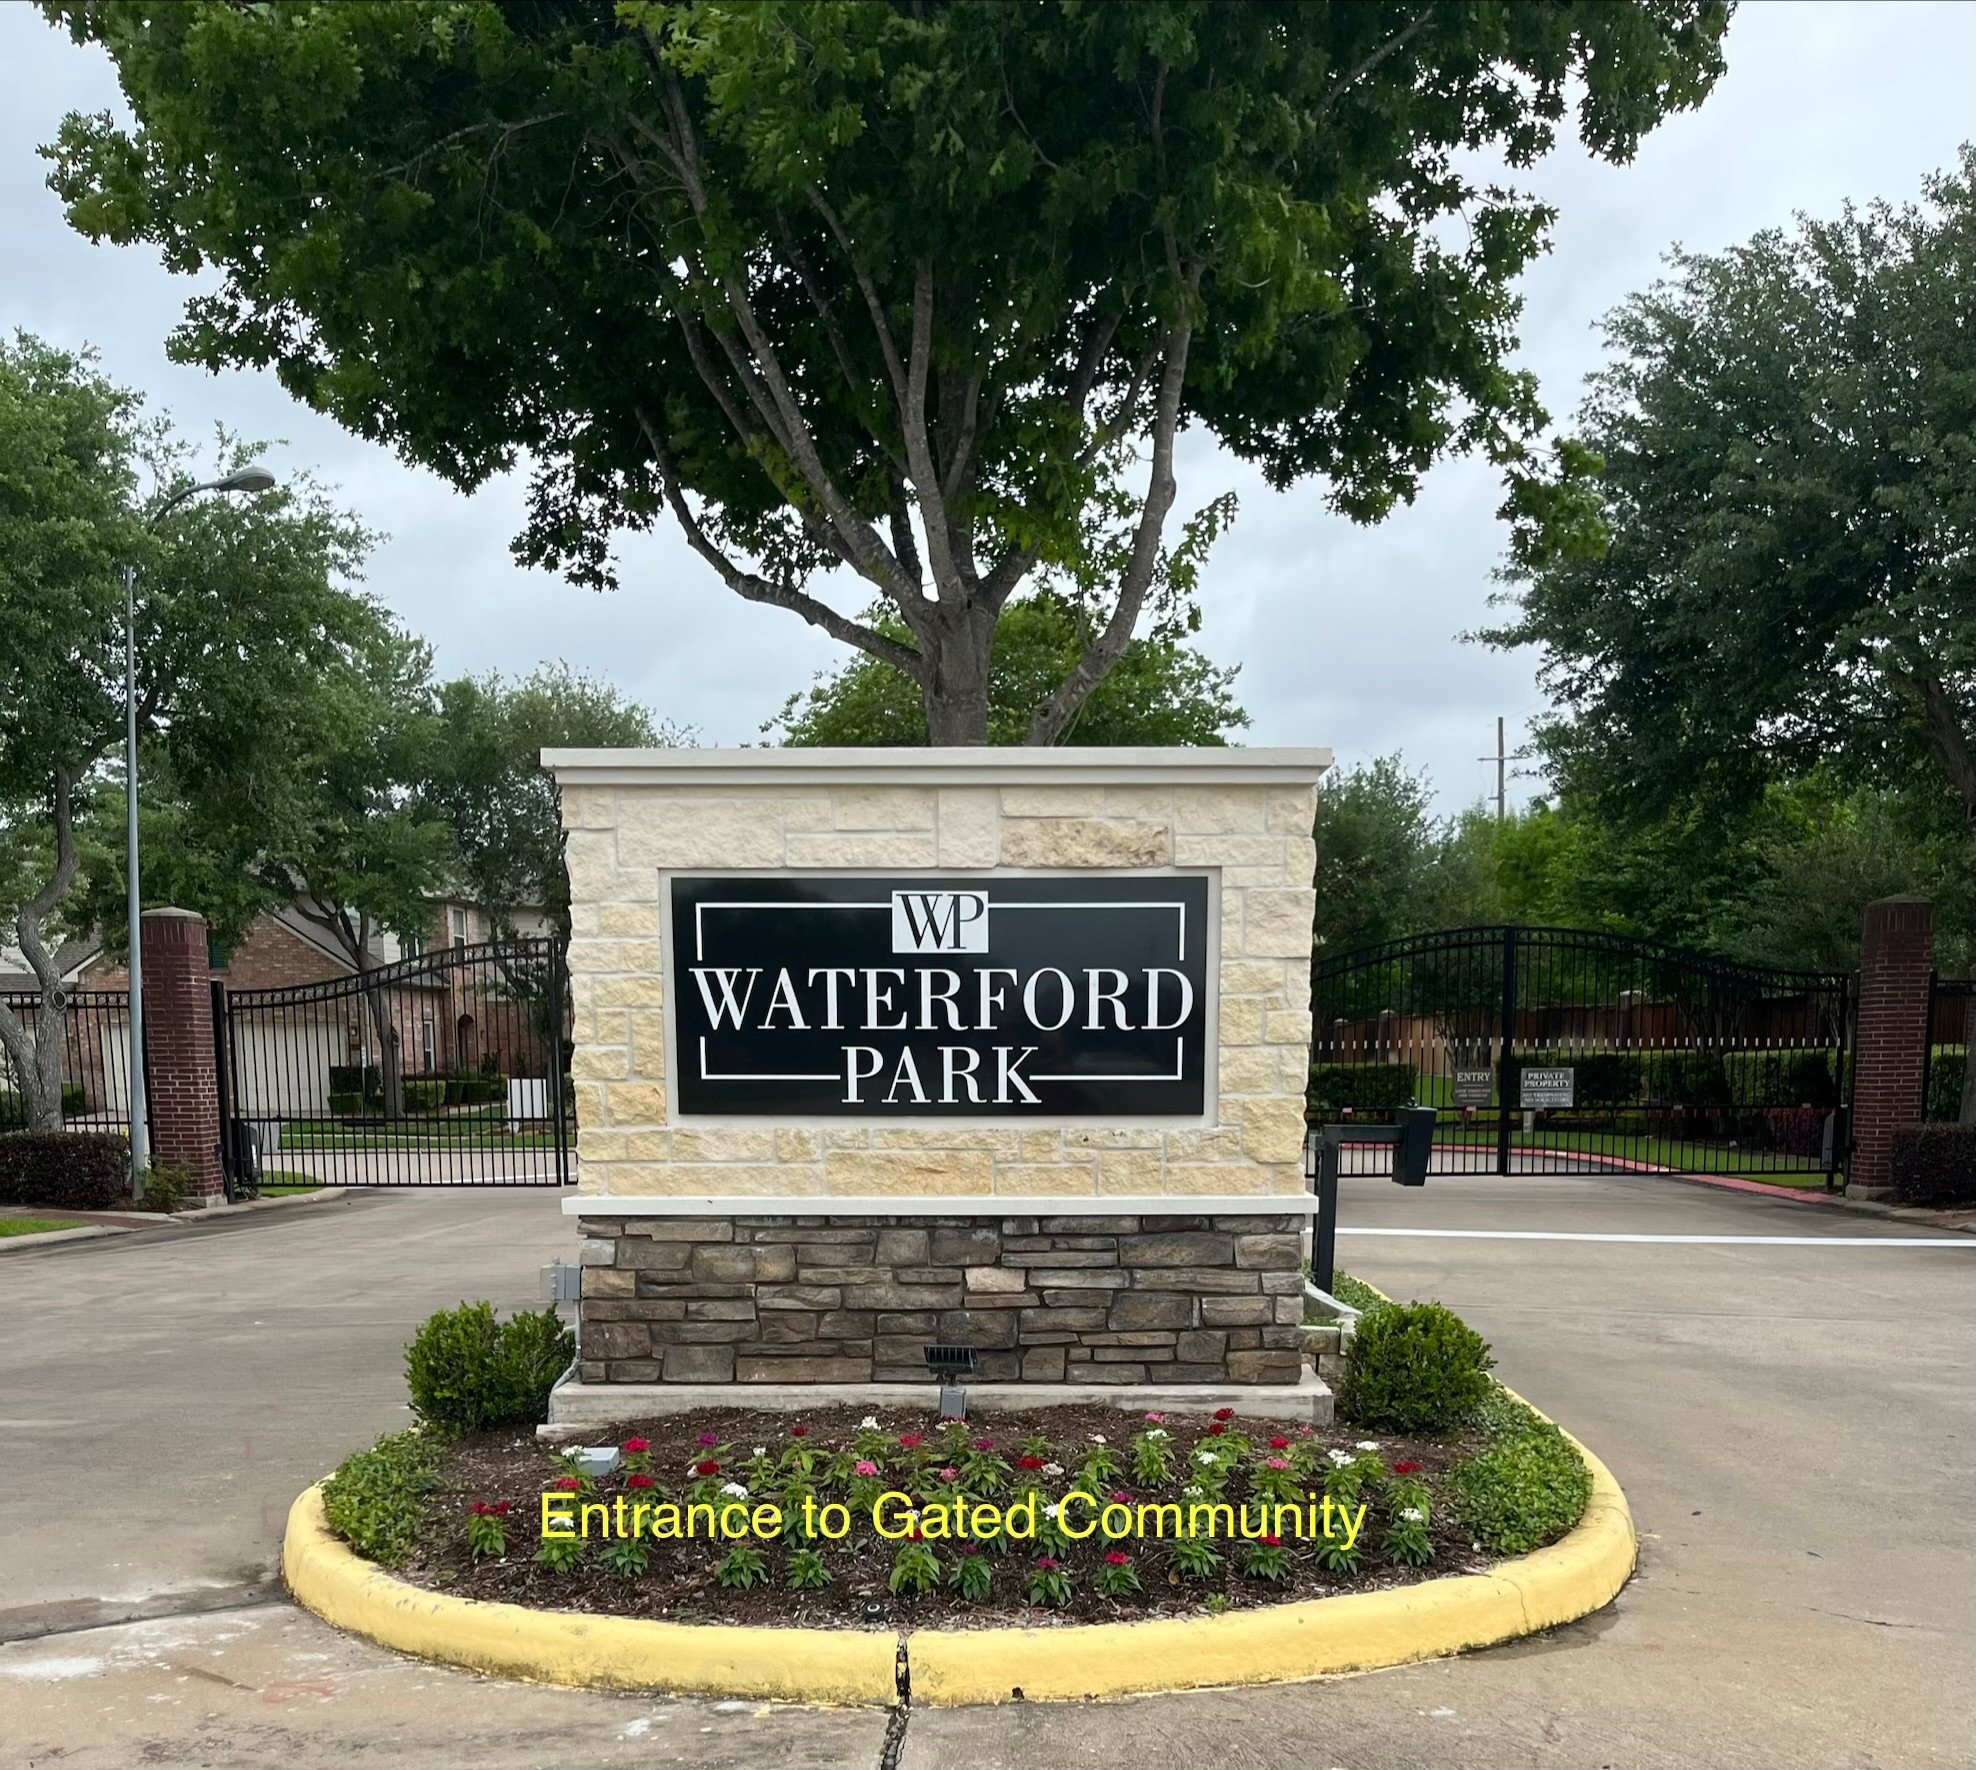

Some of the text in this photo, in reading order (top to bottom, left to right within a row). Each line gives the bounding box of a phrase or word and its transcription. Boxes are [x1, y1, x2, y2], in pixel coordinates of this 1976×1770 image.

[896, 893, 984, 950] WP
[688, 967, 1194, 1031] WATERFORD
[840, 1046, 1043, 1104] PARK
[1457, 1072, 1491, 1082] ENTRY
[1524, 1080, 1570, 1088] PROPERTY
[1527, 1072, 1564, 1080] PRIVATE
